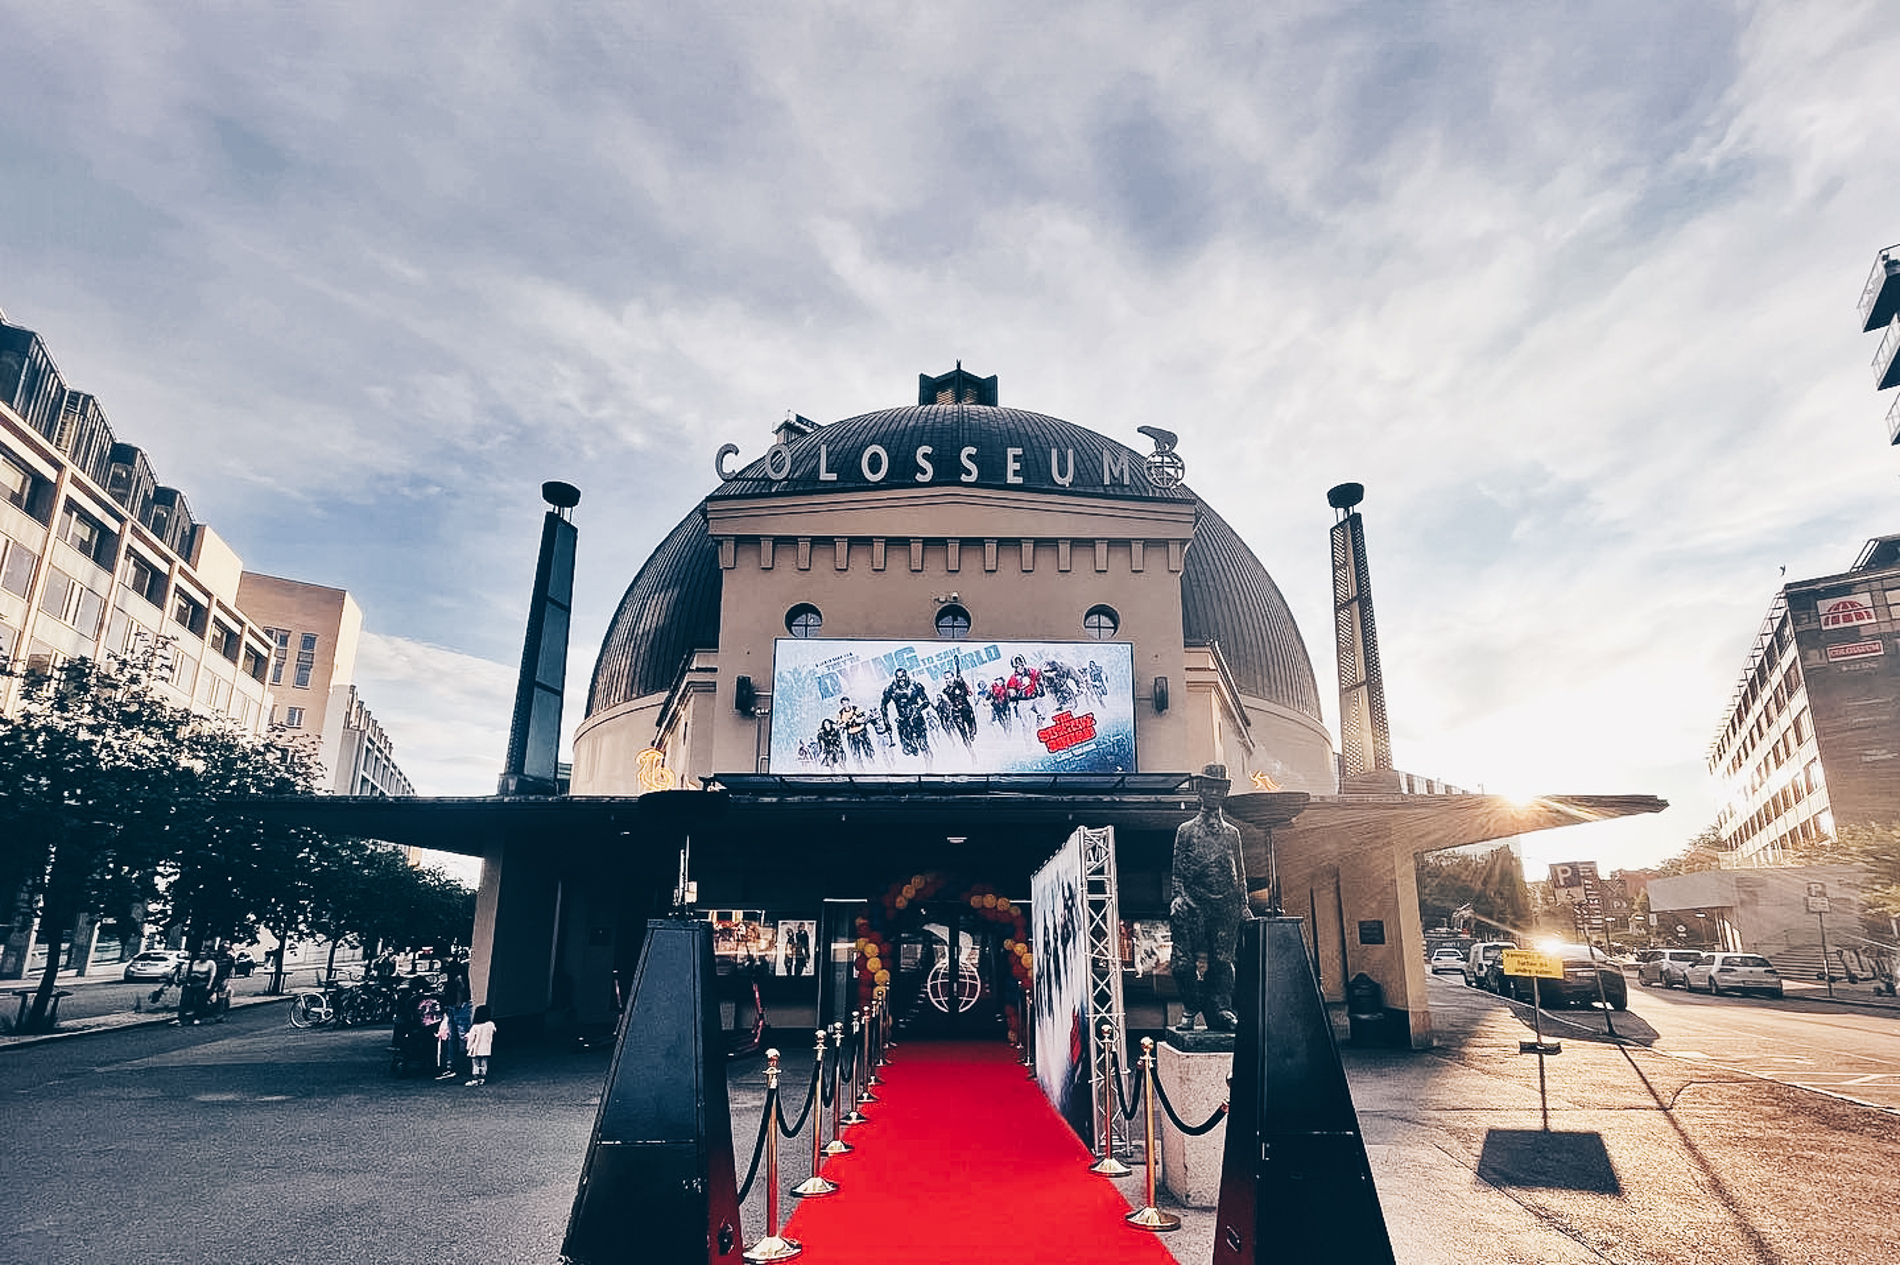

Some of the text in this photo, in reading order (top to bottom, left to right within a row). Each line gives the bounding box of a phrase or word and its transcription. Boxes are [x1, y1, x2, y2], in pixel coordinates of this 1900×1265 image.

[714, 442, 1131, 488] COLOSSEUM
[817, 646, 921, 700] DYING
[1558, 866, 1573, 886] P
